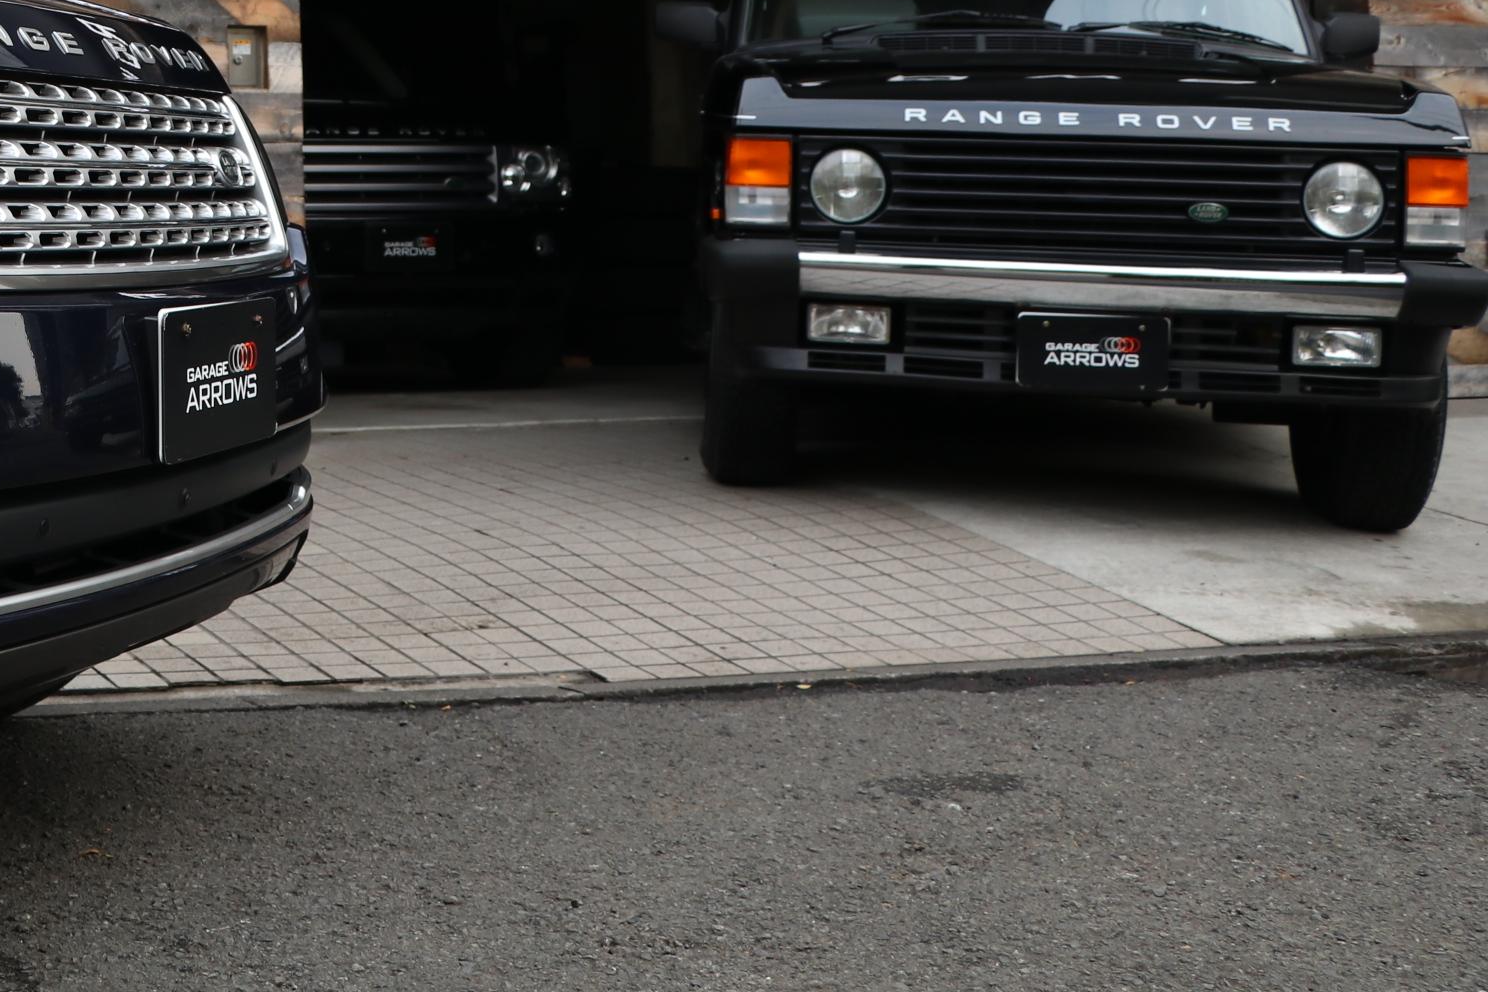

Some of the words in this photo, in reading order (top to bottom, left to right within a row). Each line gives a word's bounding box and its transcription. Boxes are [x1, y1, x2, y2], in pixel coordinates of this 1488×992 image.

[101, 36, 211, 72] ROVER
[904, 108, 1081, 127] RANGE
[1118, 113, 1293, 133] ROVER
[384, 247, 437, 257] ARROWS
[1045, 342, 1100, 353] GARAGE
[186, 360, 229, 383] GARAGE
[1043, 352, 1140, 368] ARROWS
[185, 373, 258, 414] ARROWS
